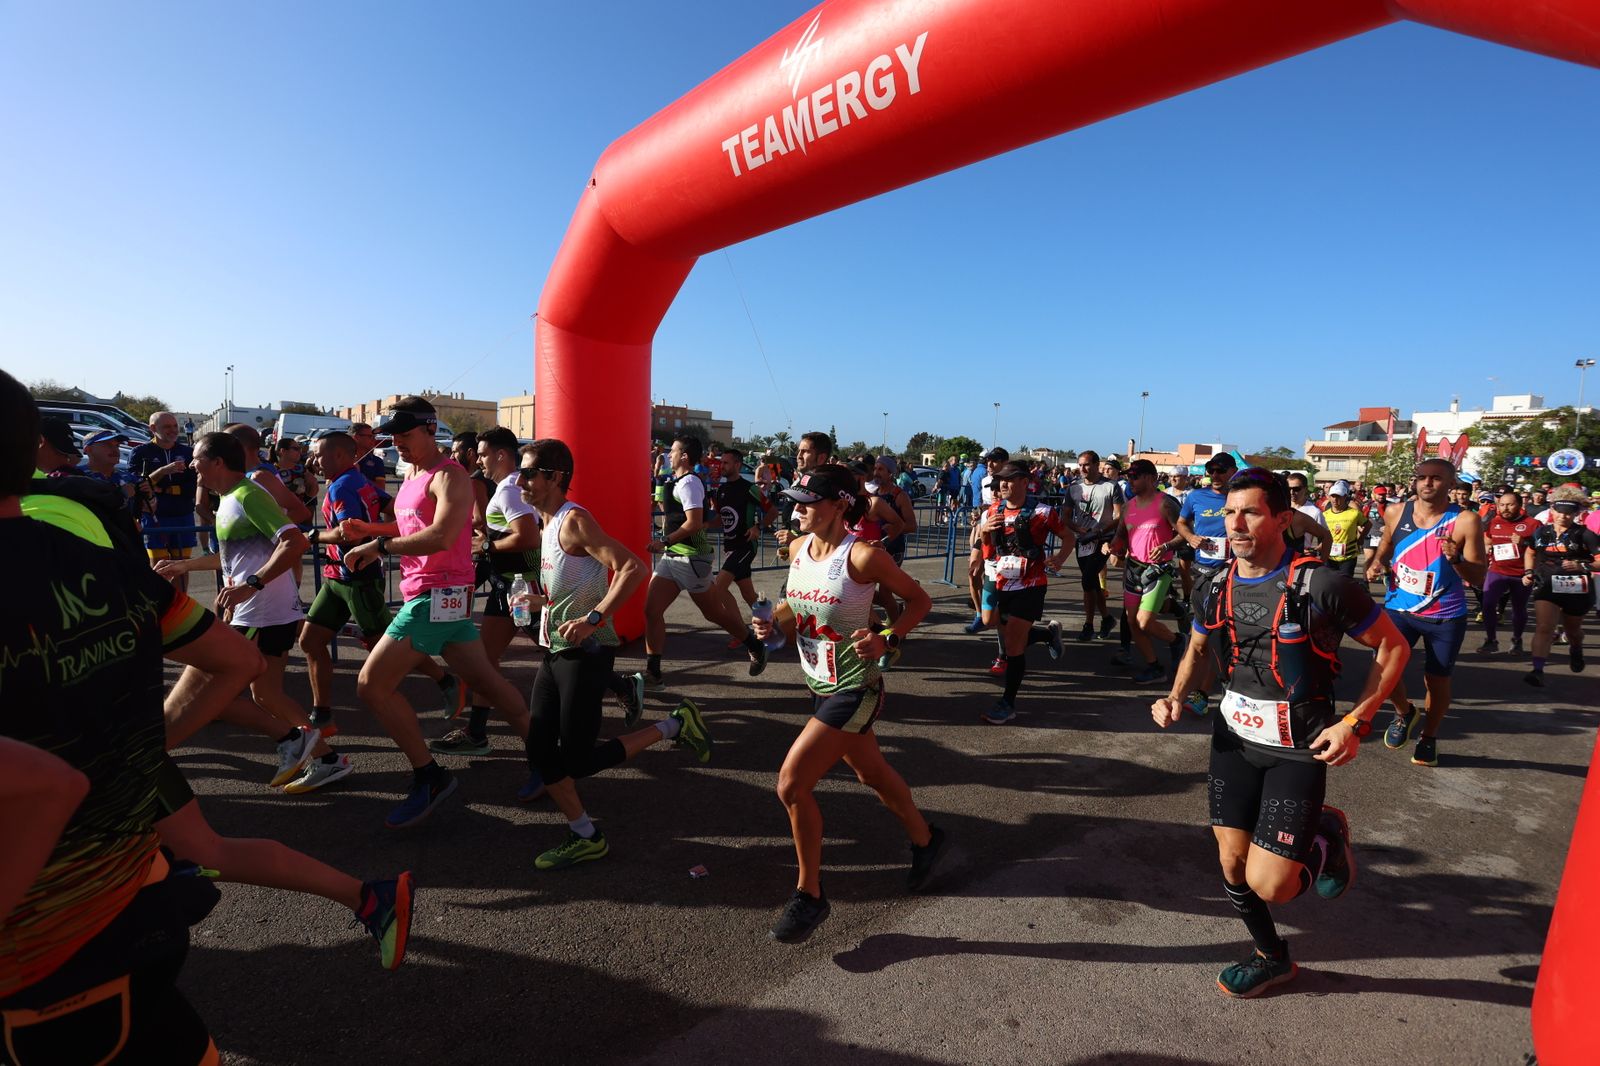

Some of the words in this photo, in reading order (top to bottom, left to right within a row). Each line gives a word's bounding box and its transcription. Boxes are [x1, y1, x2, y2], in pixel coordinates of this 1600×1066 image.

[721, 31, 929, 177] TEAMERGY
[1402, 573, 1418, 585] 239
[50, 572, 109, 630] MC
[441, 598, 462, 609] 386
[787, 588, 842, 606] aratón
[1232, 711, 1264, 729] 429
[1279, 709, 1290, 742] PIRATA
